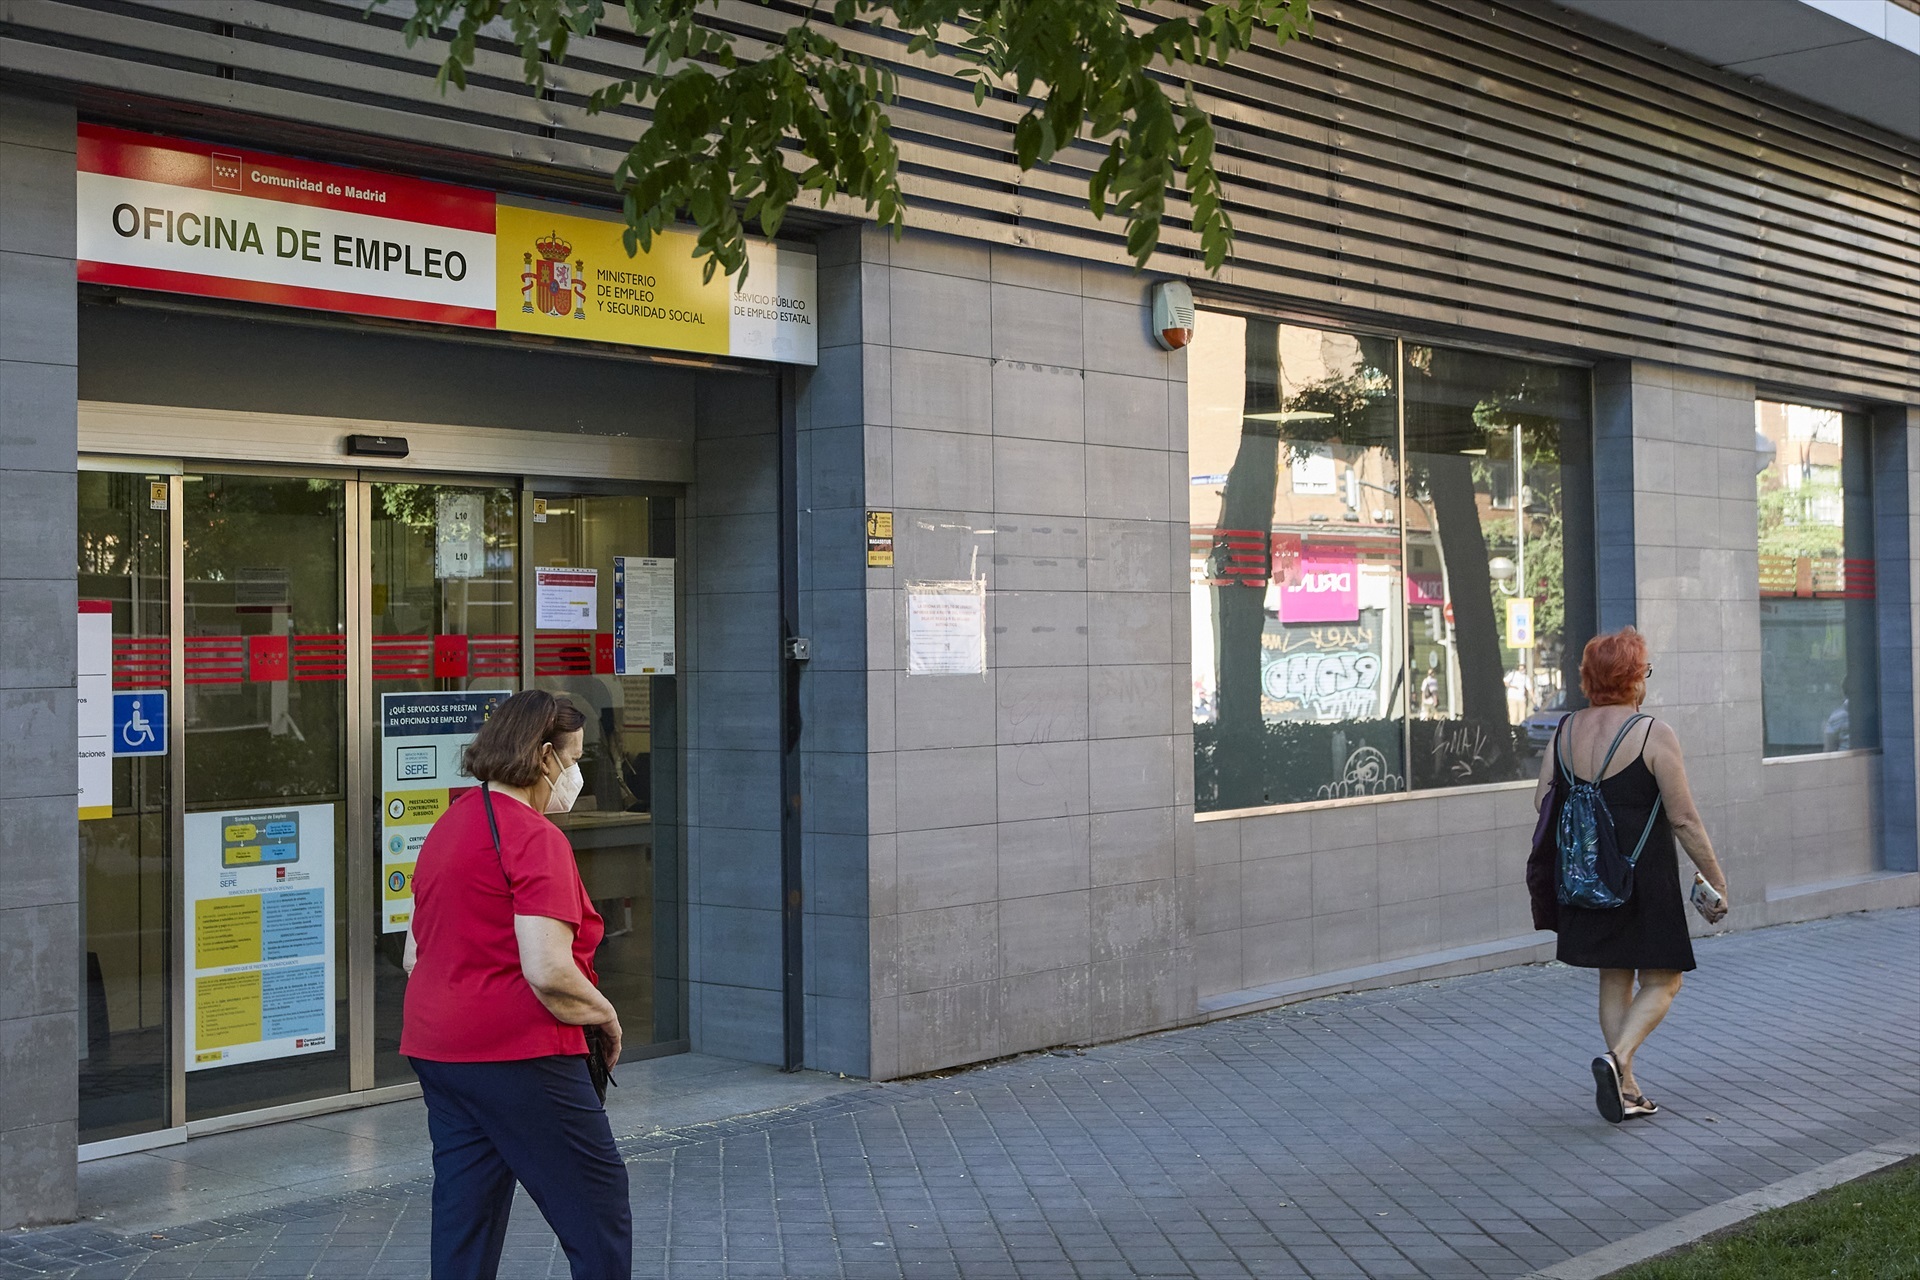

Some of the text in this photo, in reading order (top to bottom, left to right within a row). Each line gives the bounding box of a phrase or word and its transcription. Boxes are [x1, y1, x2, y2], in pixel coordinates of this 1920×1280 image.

[250, 169, 387, 204] Comunidad de Madrid
[112, 203, 468, 282] OFICINA DE EMPLEO
[597, 268, 656, 288] MINISTERIO
[597, 284, 654, 303] DE EMPLEO
[733, 291, 806, 311] SERVICIO PÚBLICO
[596, 300, 706, 325] Y SEGURIDAD SOCIAL
[733, 305, 811, 325] DE EMPLEO ESTATAL
[455, 512, 468, 520] L10
[455, 552, 468, 560] L10
[389, 704, 477, 716] ¿QUÉ SERVICIOS SE PRESTAN
[390, 715, 468, 726] EN OFICINAS DE EMPLEO?
[405, 764, 429, 775] SEPE
[220, 879, 237, 888] SEPE
